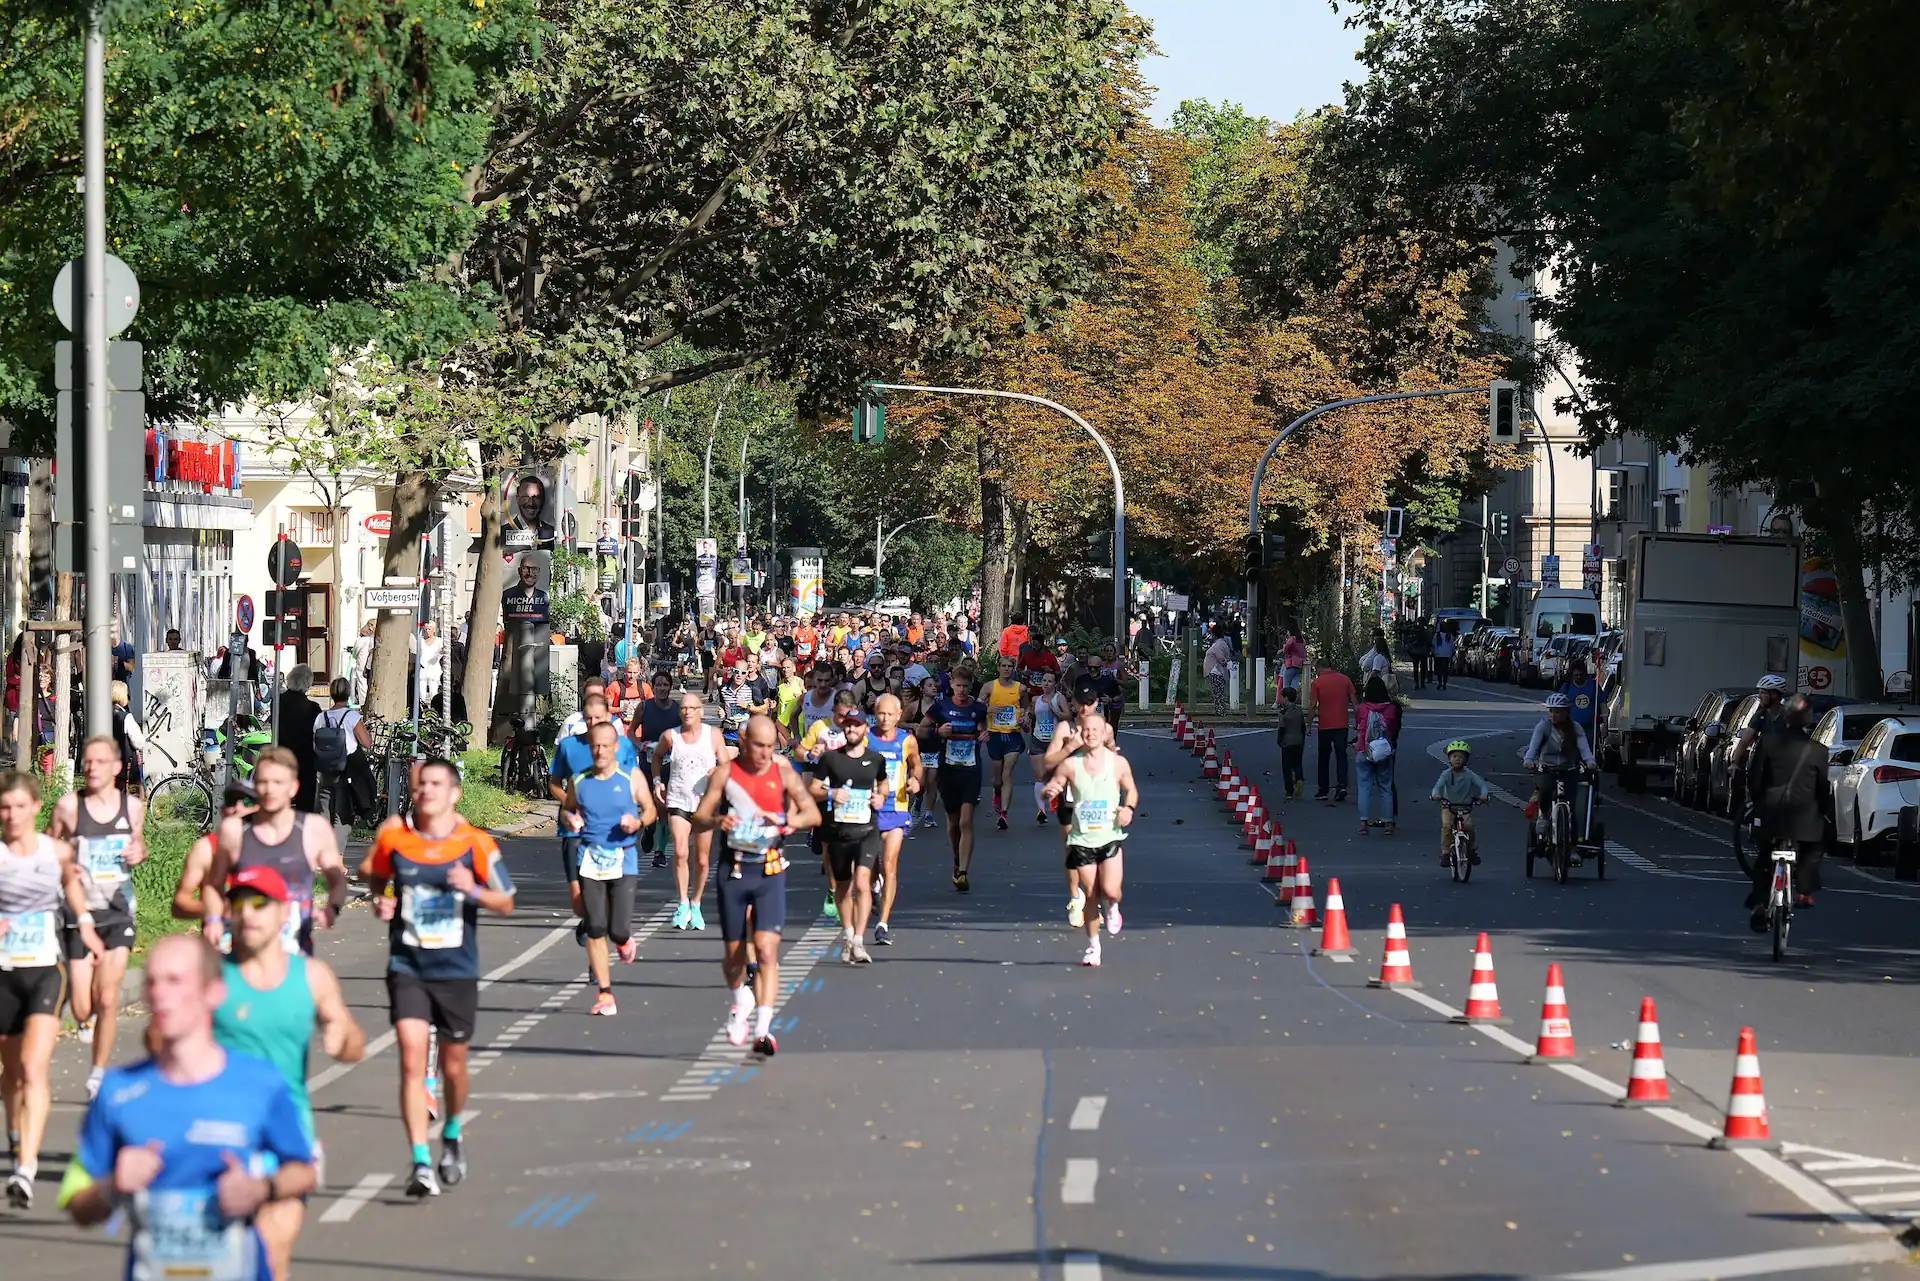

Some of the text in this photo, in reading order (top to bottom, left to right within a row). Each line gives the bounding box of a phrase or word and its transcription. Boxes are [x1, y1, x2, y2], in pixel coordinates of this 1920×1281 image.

[310, 512, 350, 544] TROO
[802, 557, 820, 567] NO
[1507, 561, 1517, 570] 50
[506, 597, 545, 605] MICHAEL
[515, 604, 535, 612] BIEL
